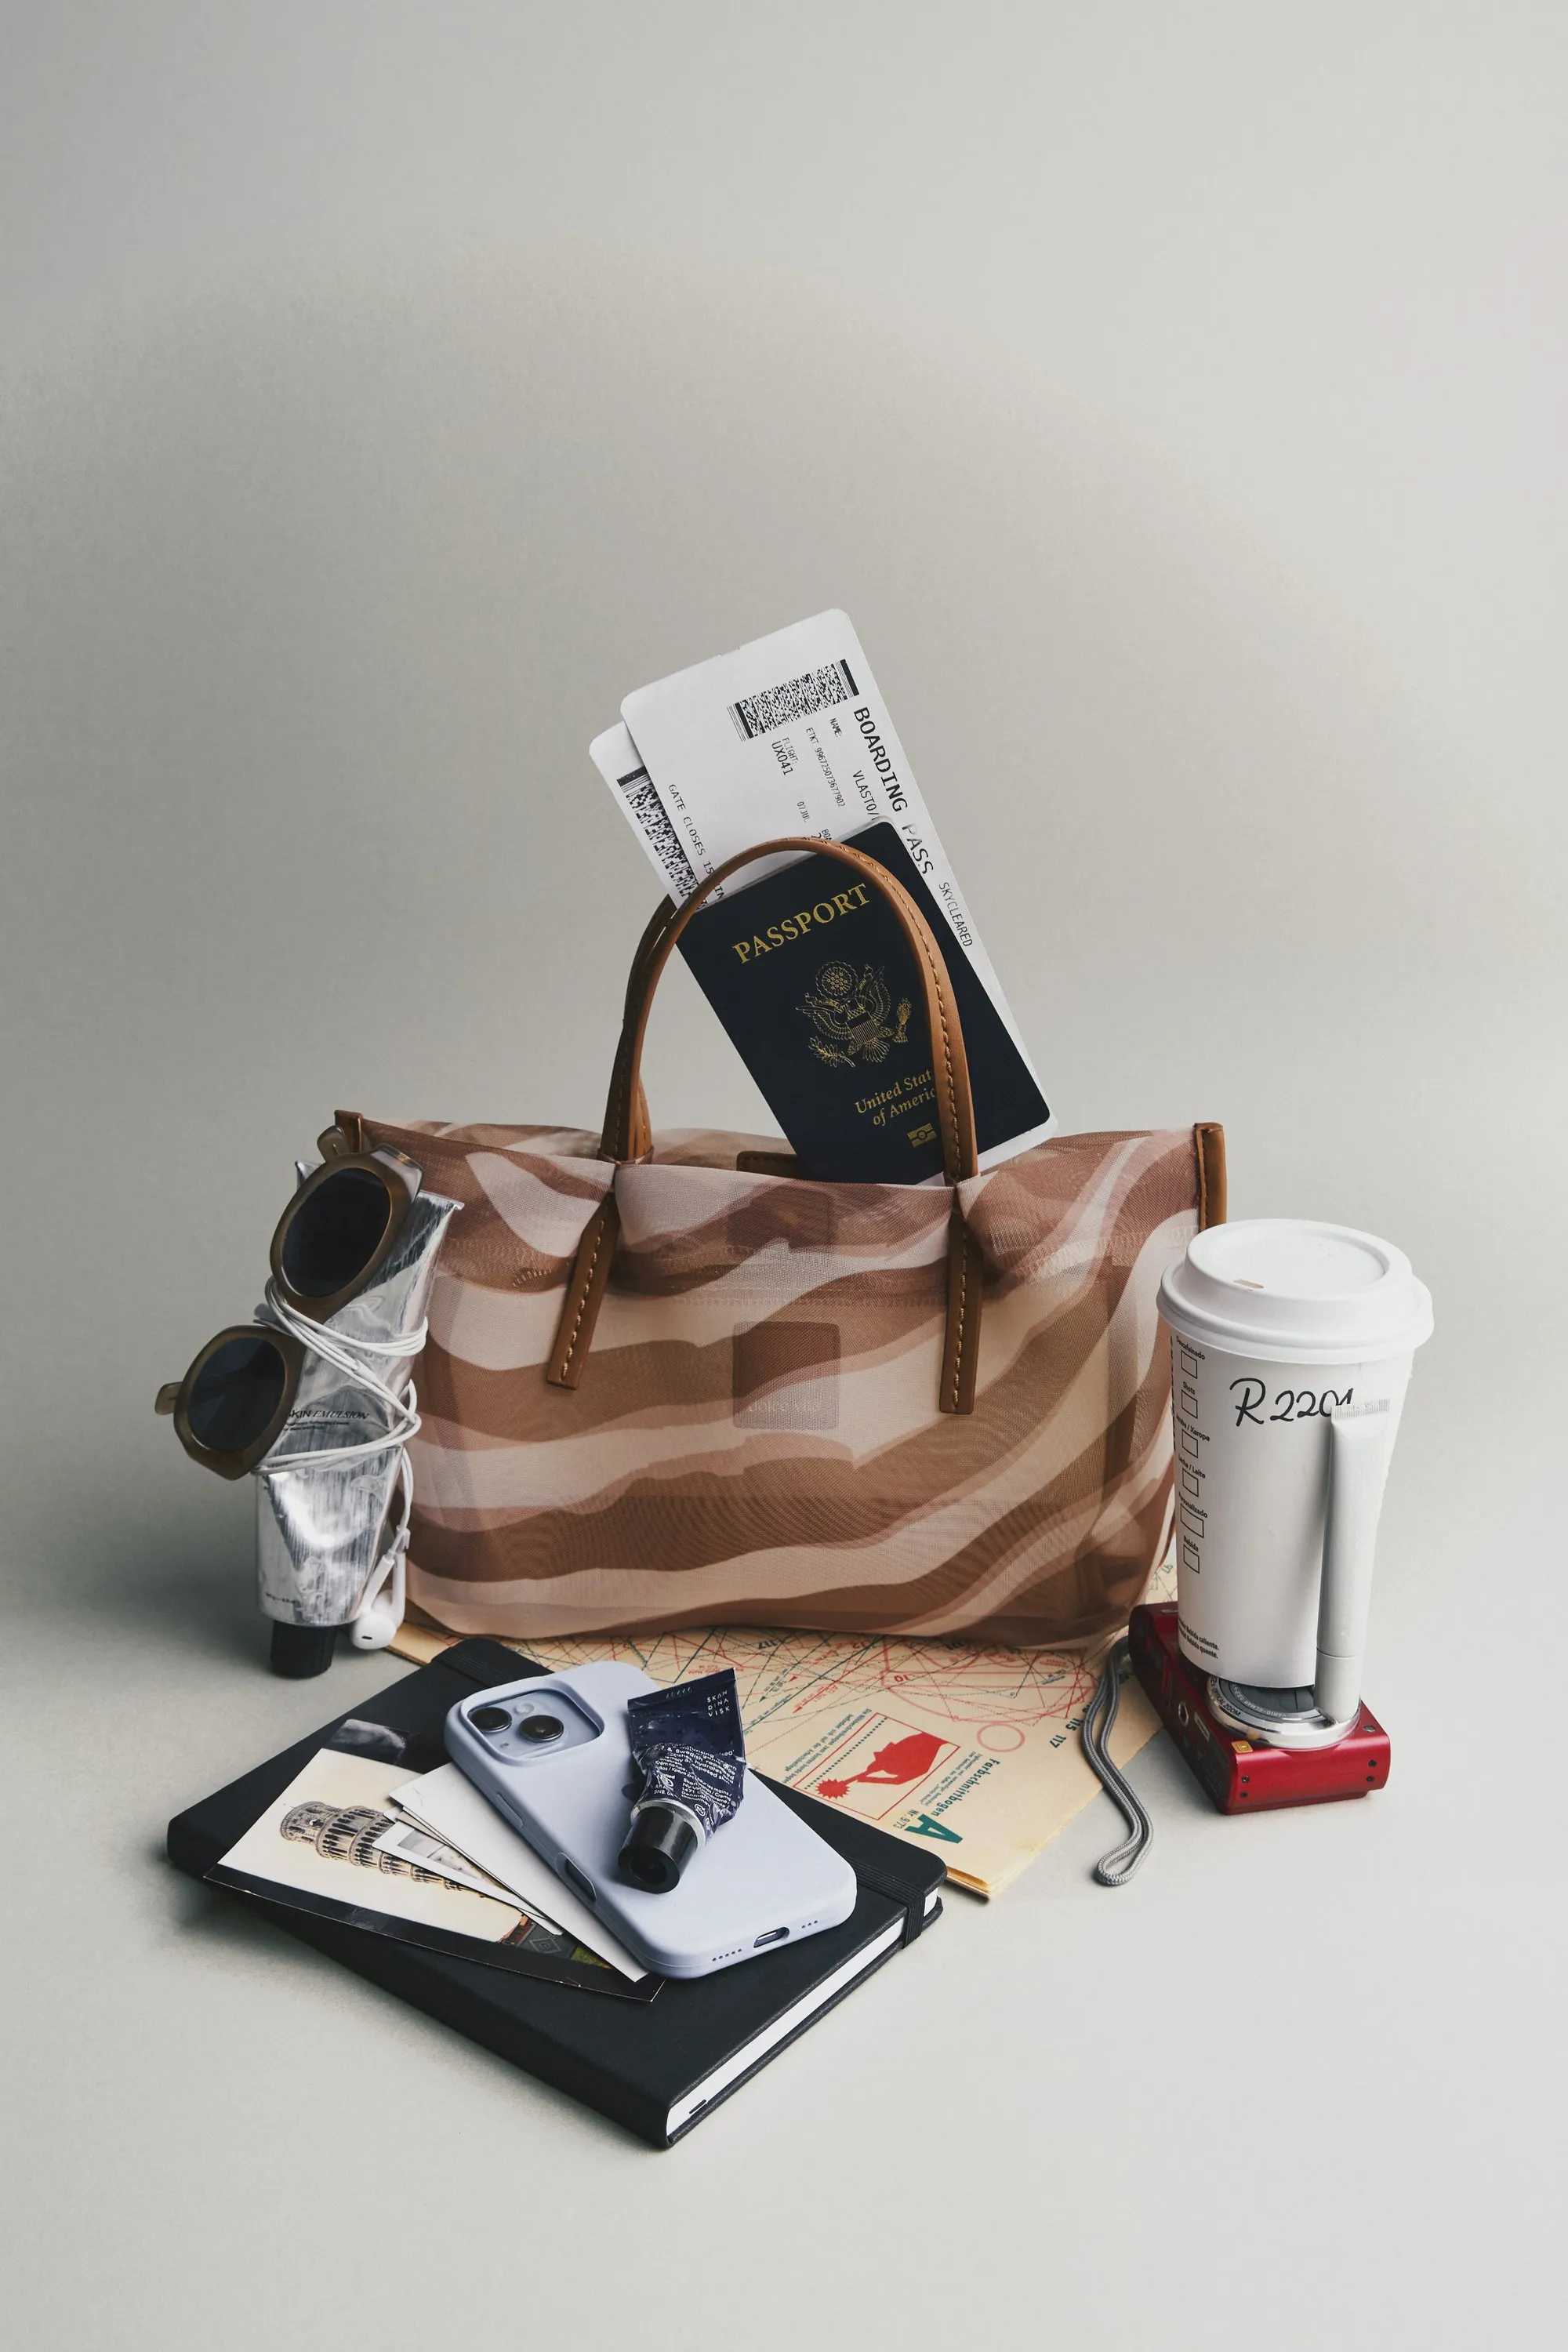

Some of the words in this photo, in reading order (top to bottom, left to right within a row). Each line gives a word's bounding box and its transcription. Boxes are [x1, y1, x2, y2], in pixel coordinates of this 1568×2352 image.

[806, 728, 818, 744] ETKT
[782, 737, 799, 764] FLIGHT:
[829, 717, 843, 738] NAME:
[853, 770, 880, 820] VLASTO/
[771, 740, 793, 775] UX041
[797, 801, 811, 822] 07JUL
[668, 785, 687, 811] GATE
[683, 816, 706, 856] CLOSES
[703, 861, 715, 874] 15
[854, 707, 907, 812] BOARDING
[902, 823, 934, 874] PASS
[939, 881, 973, 947] SKYCLEARED
[732, 883, 869, 964] PASSPORT
[855, 1082, 902, 1113] United
[904, 1069, 931, 1091] Stat
[873, 1108, 886, 1126] of
[890, 1088, 935, 1118] Americ
[1183, 1381, 1196, 1396] Shots
[289, 1410, 310, 1418] KIN
[312, 1410, 369, 1420] EMULSION
[1191, 1426, 1210, 1442] Xarope
[894, 1674, 910, 1682] 10
[708, 1698, 728, 1711] DINA
[708, 1705, 730, 1717] VISK
[1223, 1703, 1242, 1717] ZOOM
[1065, 1718, 1083, 1731] 115
[1049, 1734, 1067, 1748] 117
[931, 1758, 1000, 1817] Farbschnittbogen
[904, 1813, 963, 1844] A
